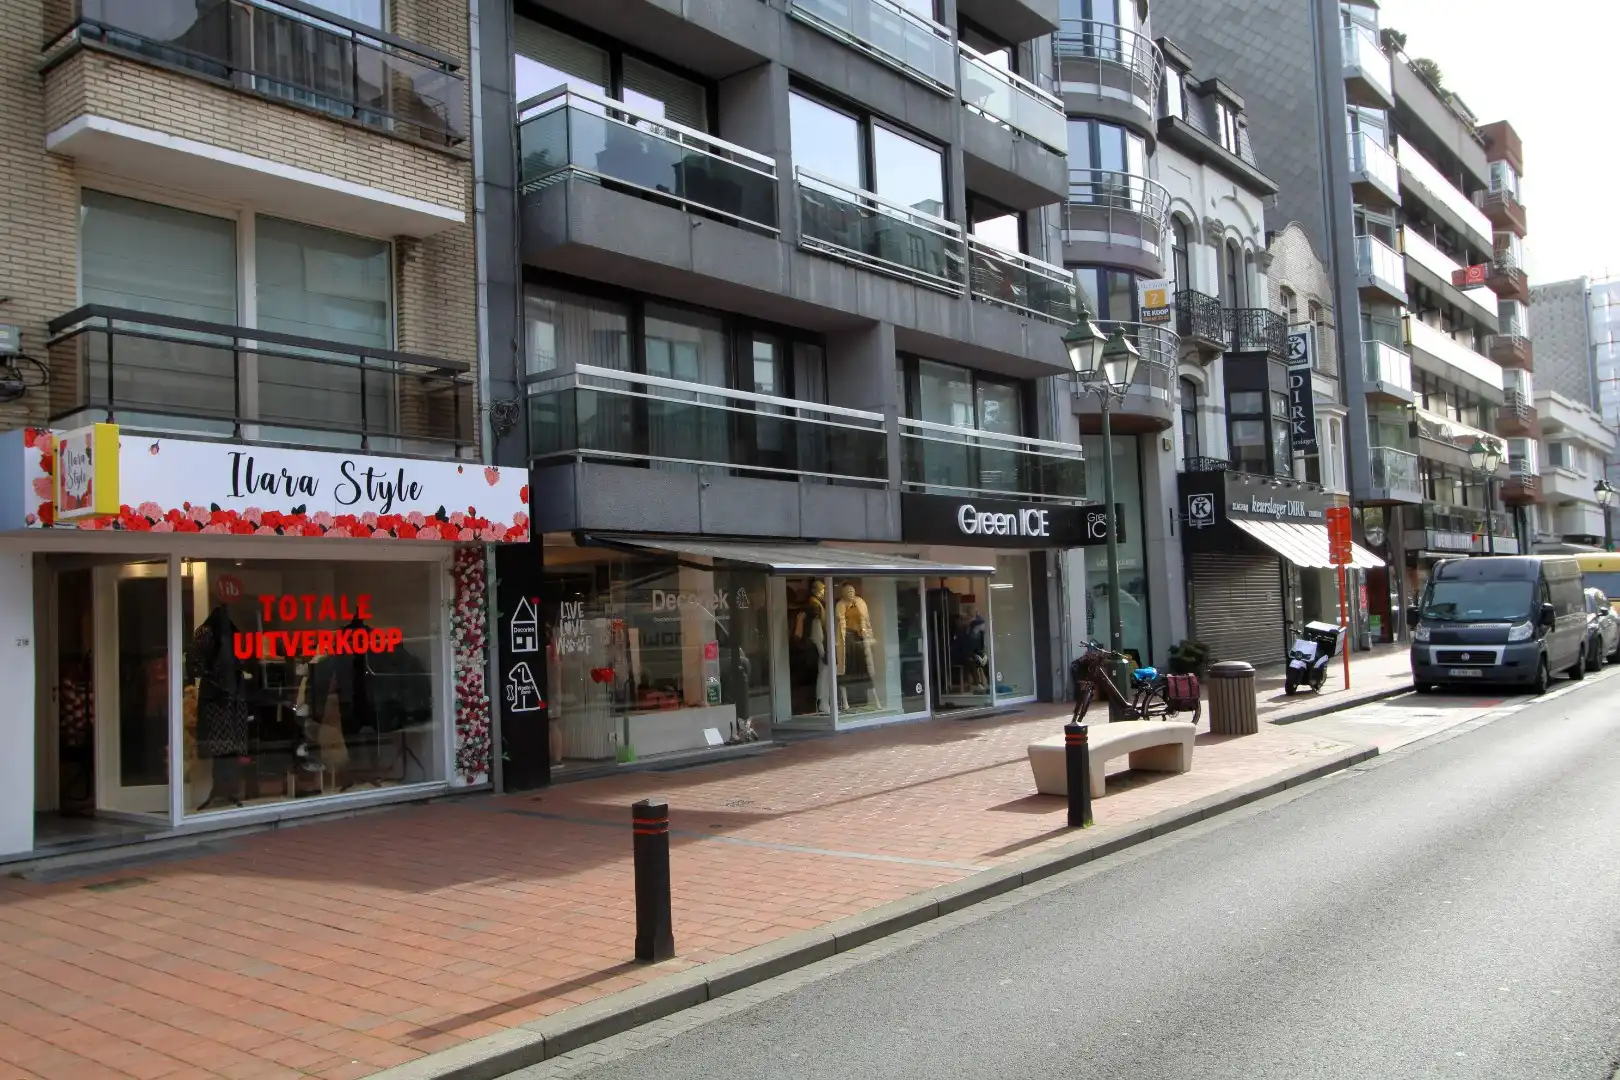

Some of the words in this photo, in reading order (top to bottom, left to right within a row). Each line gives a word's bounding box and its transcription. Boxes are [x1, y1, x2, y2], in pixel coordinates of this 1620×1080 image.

[1152, 308, 1169, 316] KOOP
[1289, 342, 1302, 355] K
[1290, 375, 1306, 434] DIRK
[67, 466, 86, 490] Style
[227, 451, 319, 499] Ilara
[334, 460, 423, 514] Style
[1087, 512, 1108, 522] Gre
[1194, 502, 1208, 515] K
[1251, 495, 1287, 519] keurslager
[1287, 500, 1306, 517] DIRK
[957, 504, 1018, 536] Green
[1018, 508, 1050, 537] ICE
[1087, 521, 1108, 538] IC
[258, 593, 373, 622] TOTALE
[560, 600, 585, 620] LIVE
[233, 627, 403, 660] UITVERKOOP
